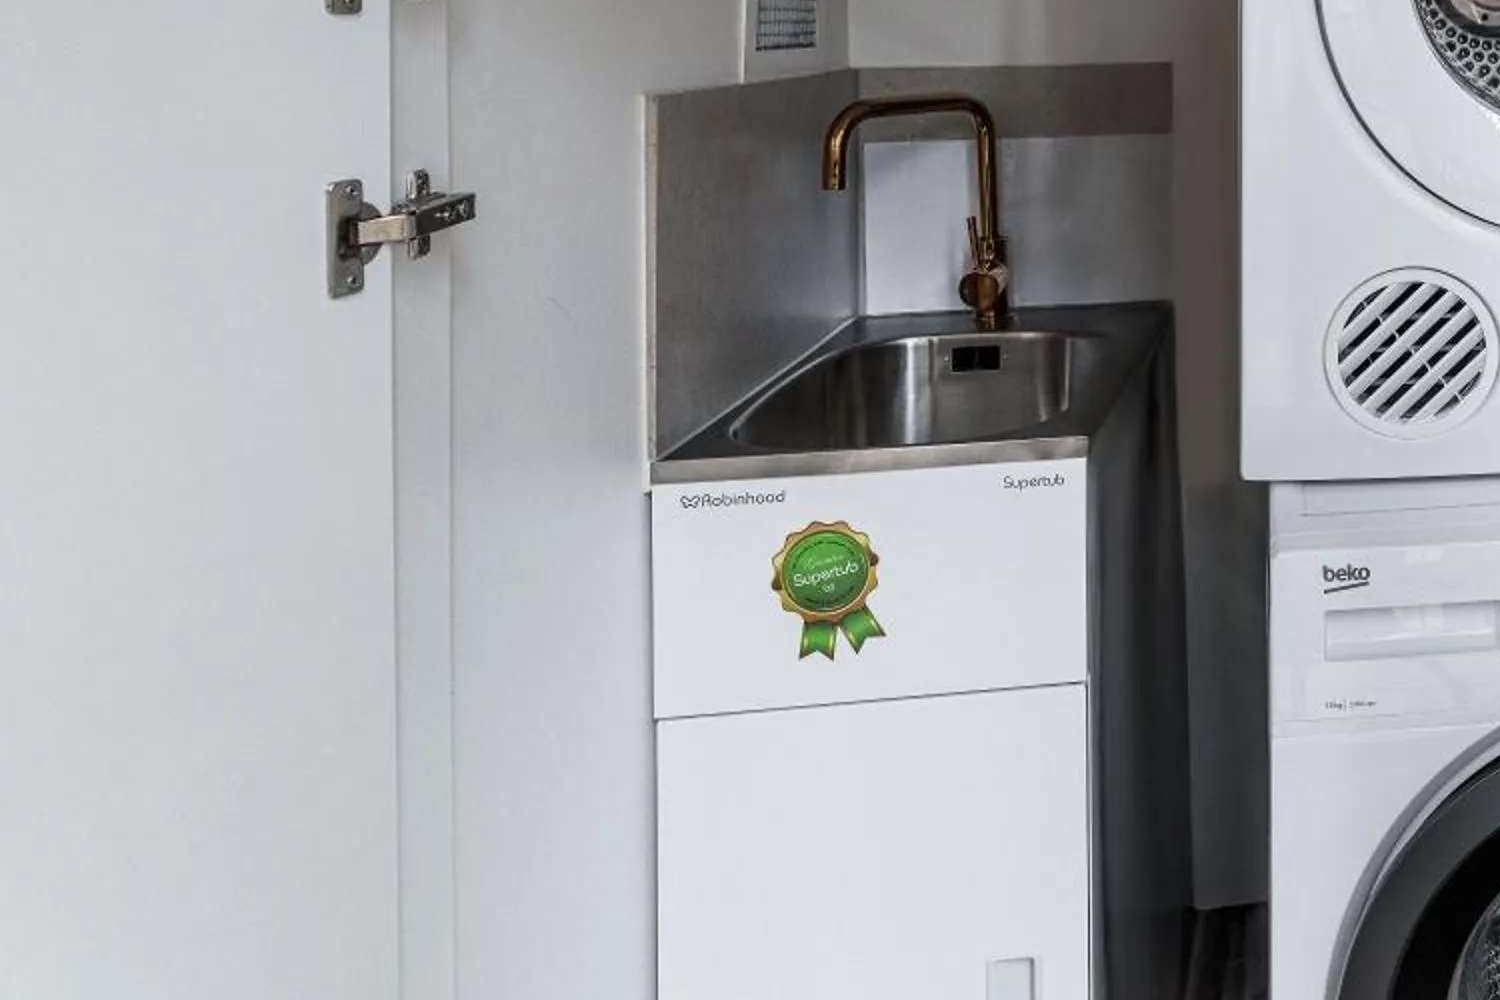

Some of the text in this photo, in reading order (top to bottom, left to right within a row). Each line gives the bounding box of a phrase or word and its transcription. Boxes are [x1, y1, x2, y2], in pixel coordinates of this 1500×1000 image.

[1003, 474, 1065, 493] Supertub
[701, 489, 785, 508] Robinhood
[793, 560, 859, 587] Supertub
[1322, 563, 1371, 582] beko
